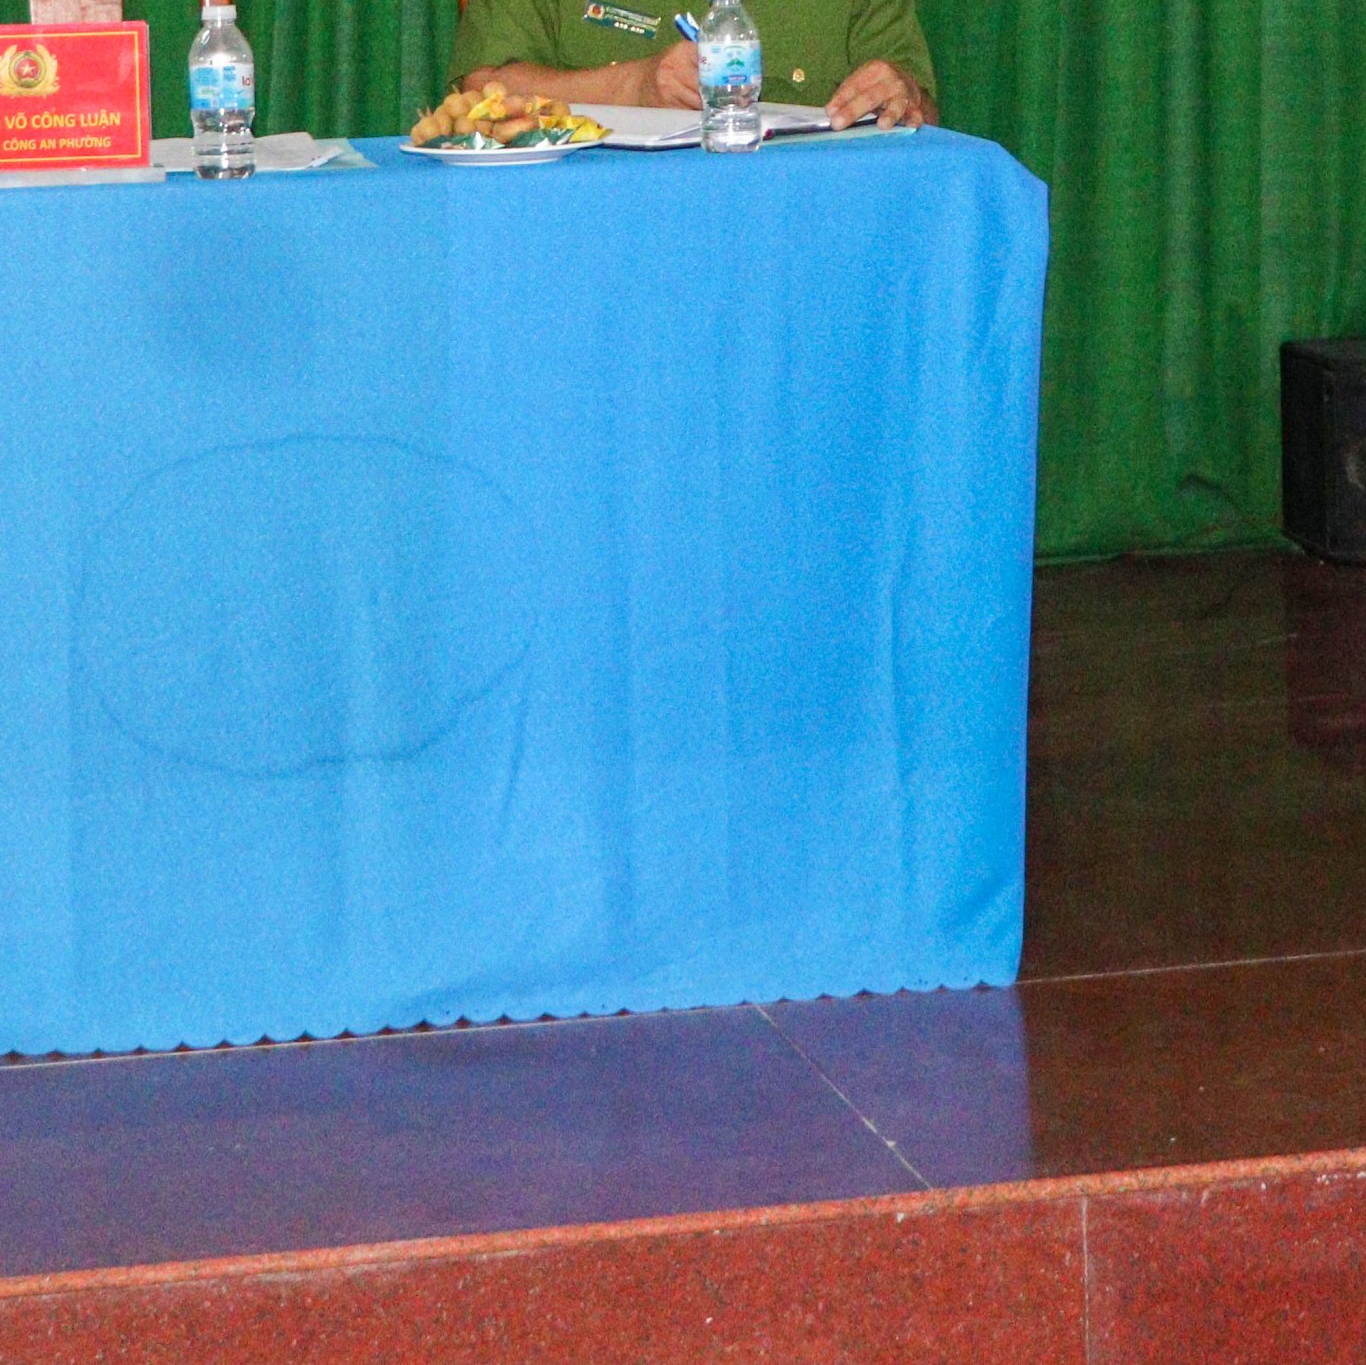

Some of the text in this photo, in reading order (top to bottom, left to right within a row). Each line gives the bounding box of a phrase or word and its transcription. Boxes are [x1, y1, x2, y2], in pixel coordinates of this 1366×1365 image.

[5, 112, 27, 130] VÕ
[31, 111, 76, 129] CÔNG
[80, 109, 121, 129] LUẬN
[3, 138, 36, 151] CÔNG
[39, 138, 56, 150] AN
[59, 136, 111, 149] PHƯỜNG
